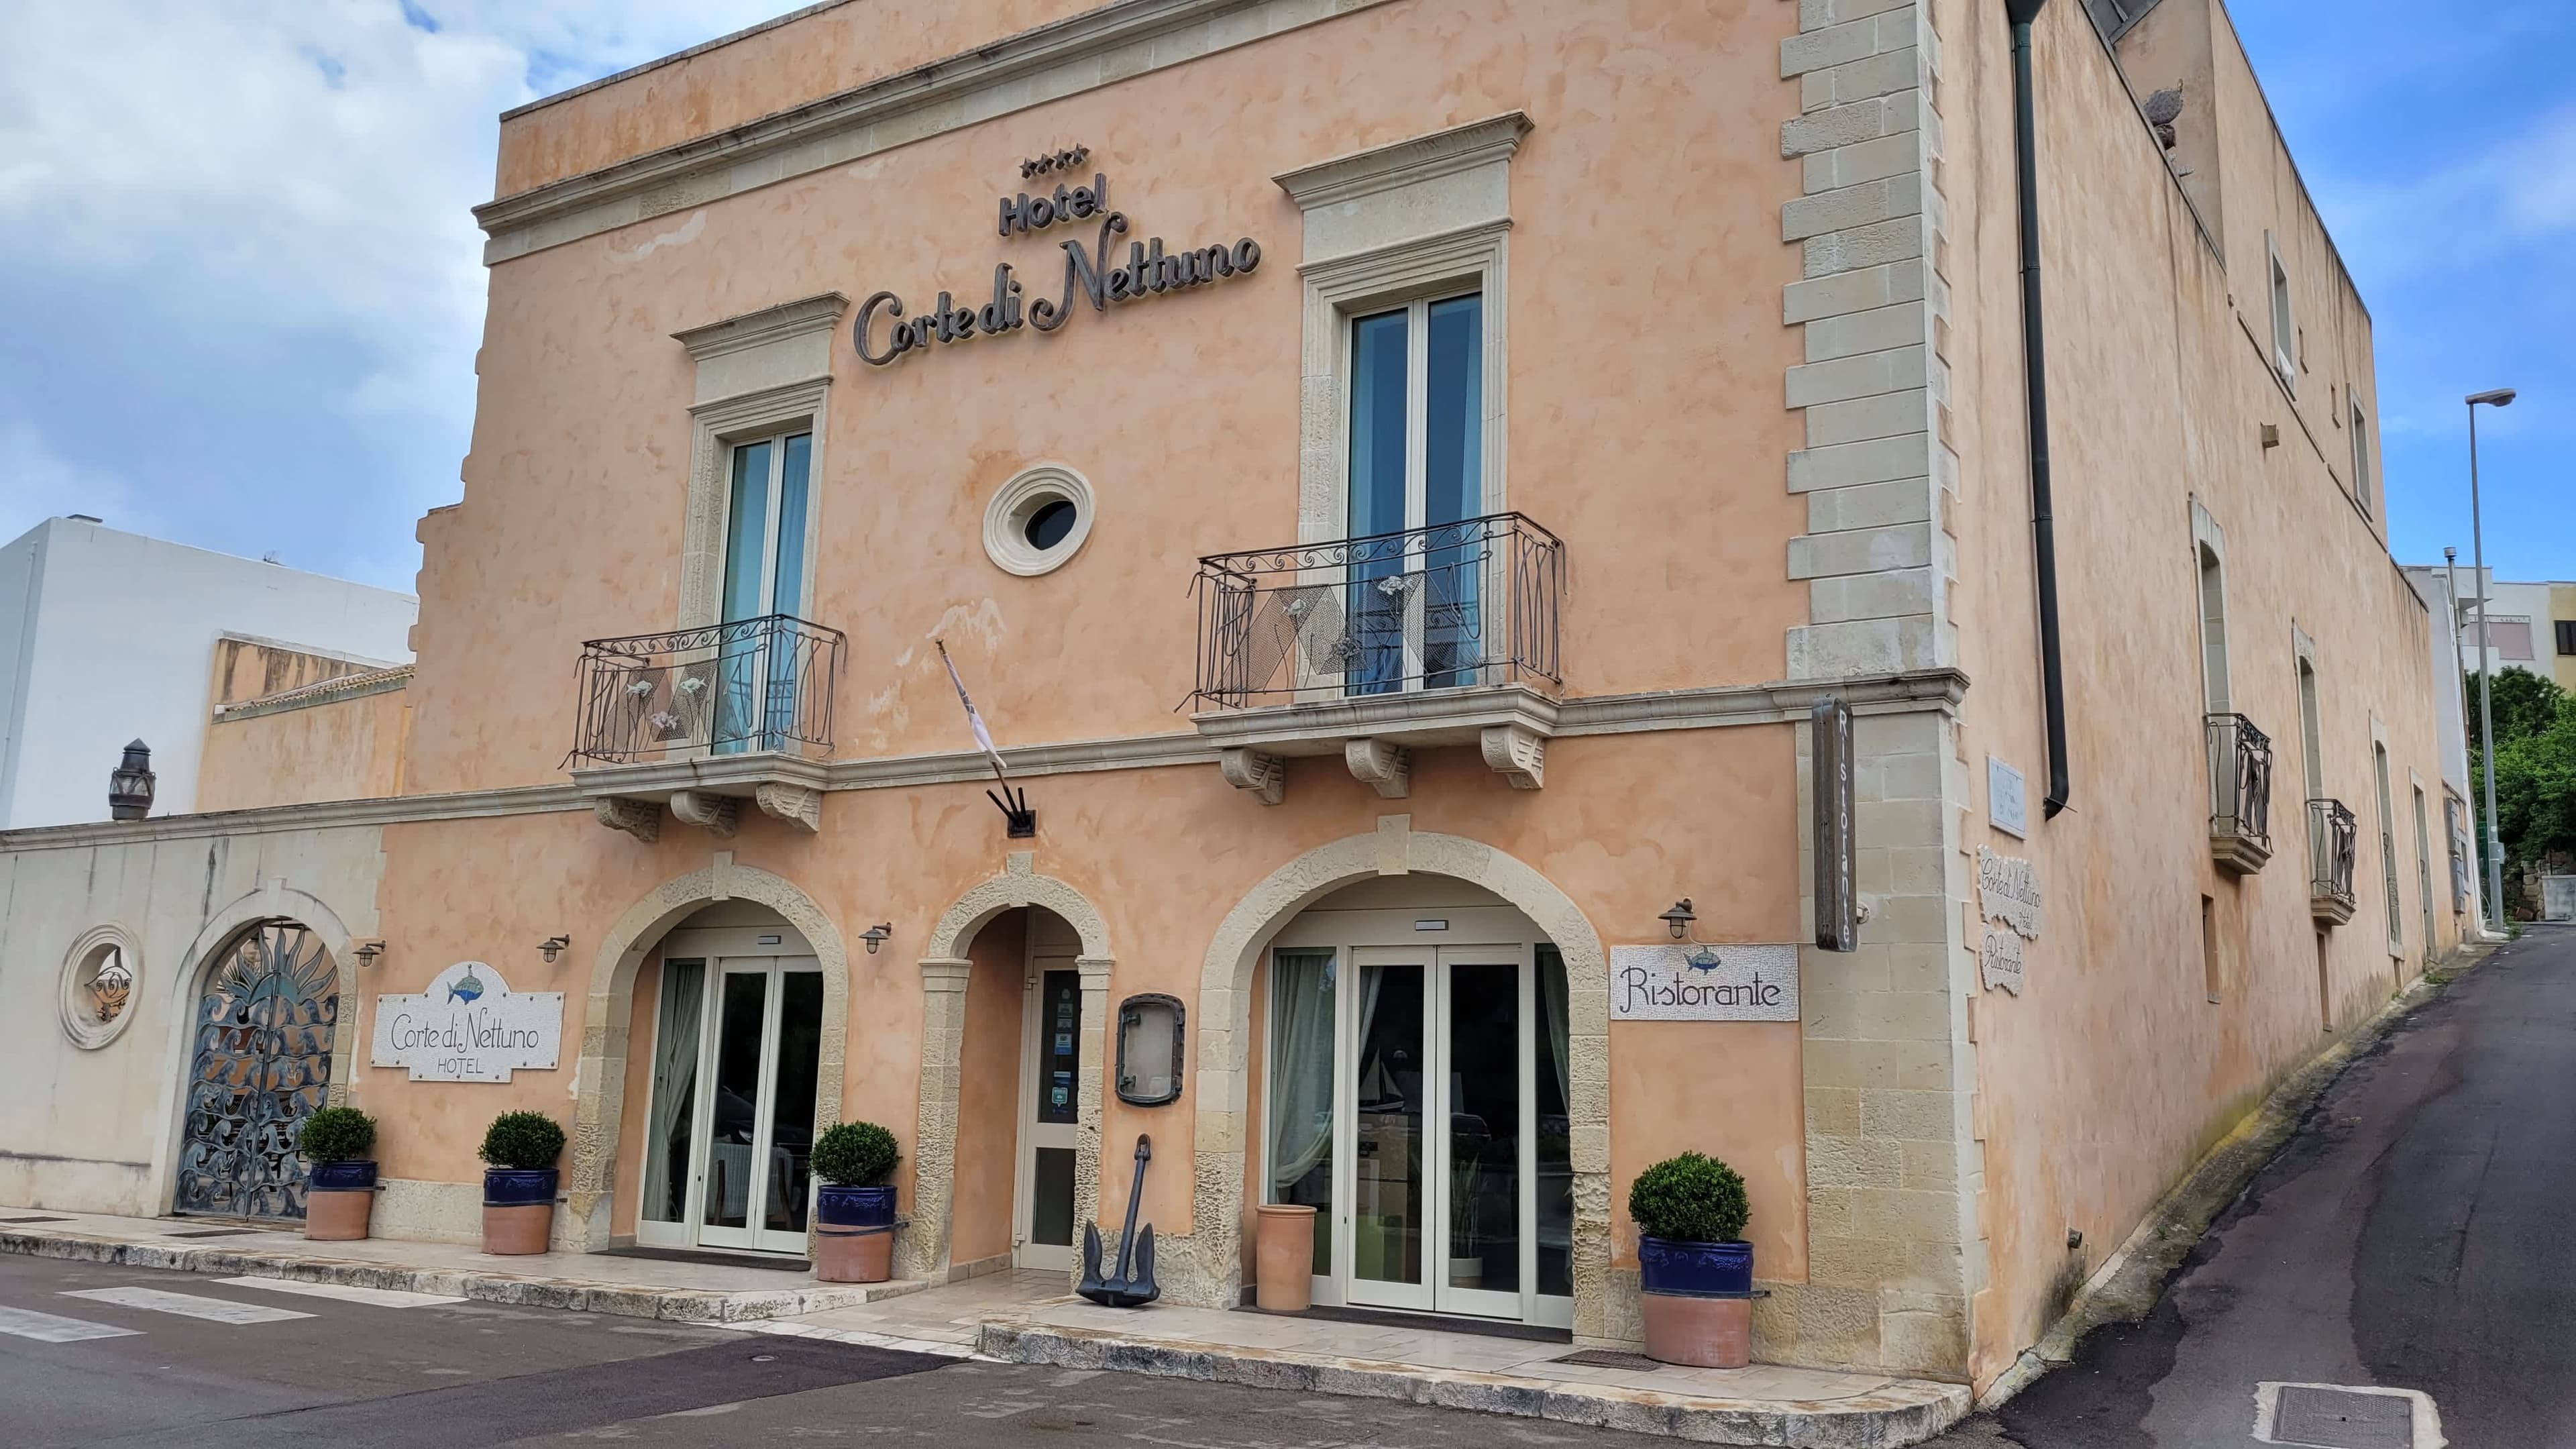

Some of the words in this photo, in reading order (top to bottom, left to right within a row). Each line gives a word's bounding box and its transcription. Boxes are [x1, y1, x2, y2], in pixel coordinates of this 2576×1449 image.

[998, 172, 1108, 237] Hotel
[853, 290, 975, 366] Corte
[977, 262, 1024, 335] di
[1028, 211, 1261, 331] Nettuno
[1839, 709, 1850, 943] Ristorante
[1984, 934, 2022, 974] Ristorante
[1619, 965, 1781, 1014] Ristorante
[391, 1014, 439, 1051] Corte
[441, 1013, 458, 1048] di
[456, 1007, 539, 1053] Nettuno
[437, 1058, 484, 1074] HOTEL
